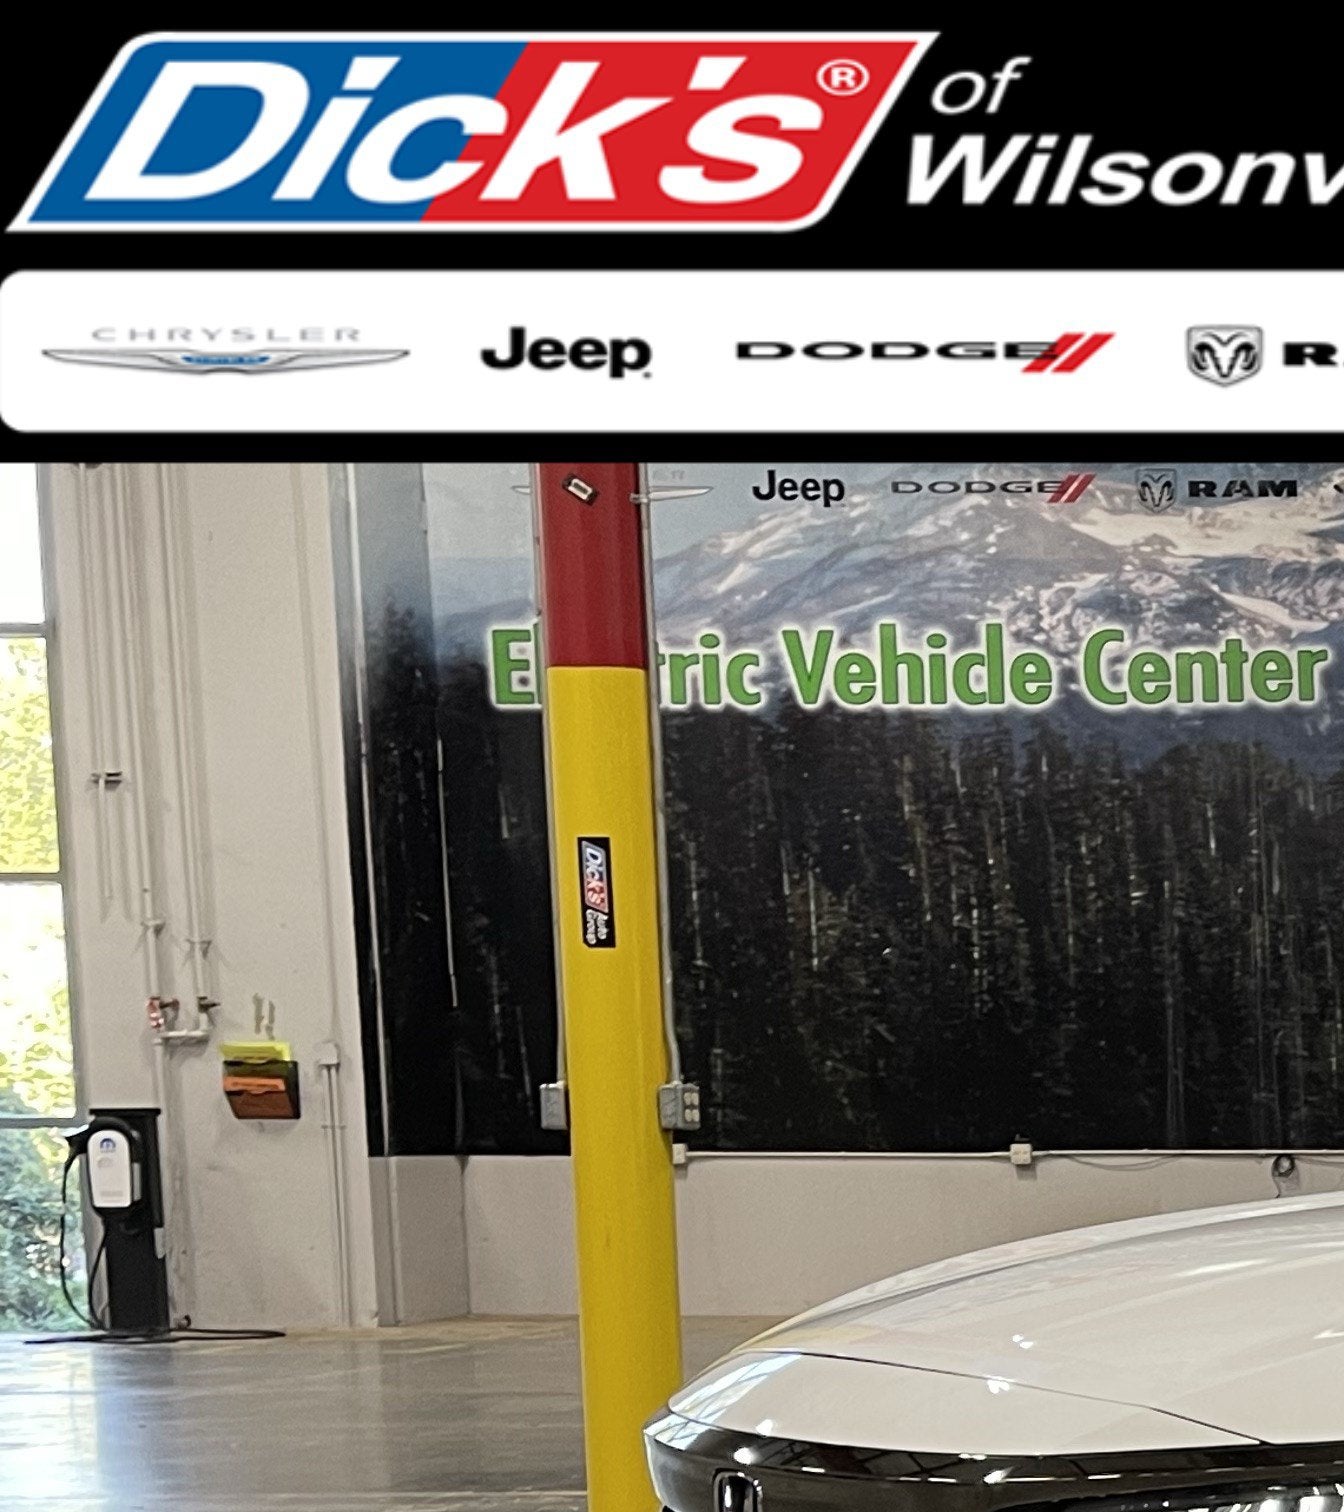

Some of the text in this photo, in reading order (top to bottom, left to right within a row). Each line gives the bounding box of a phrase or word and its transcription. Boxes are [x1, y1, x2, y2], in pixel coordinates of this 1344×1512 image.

[752, 469, 845, 508] Jeep
[891, 480, 1066, 494] DODGE
[1188, 480, 1298, 498] RAM
[780, 623, 1053, 706] Vehicle
[1082, 628, 1329, 705] Center
